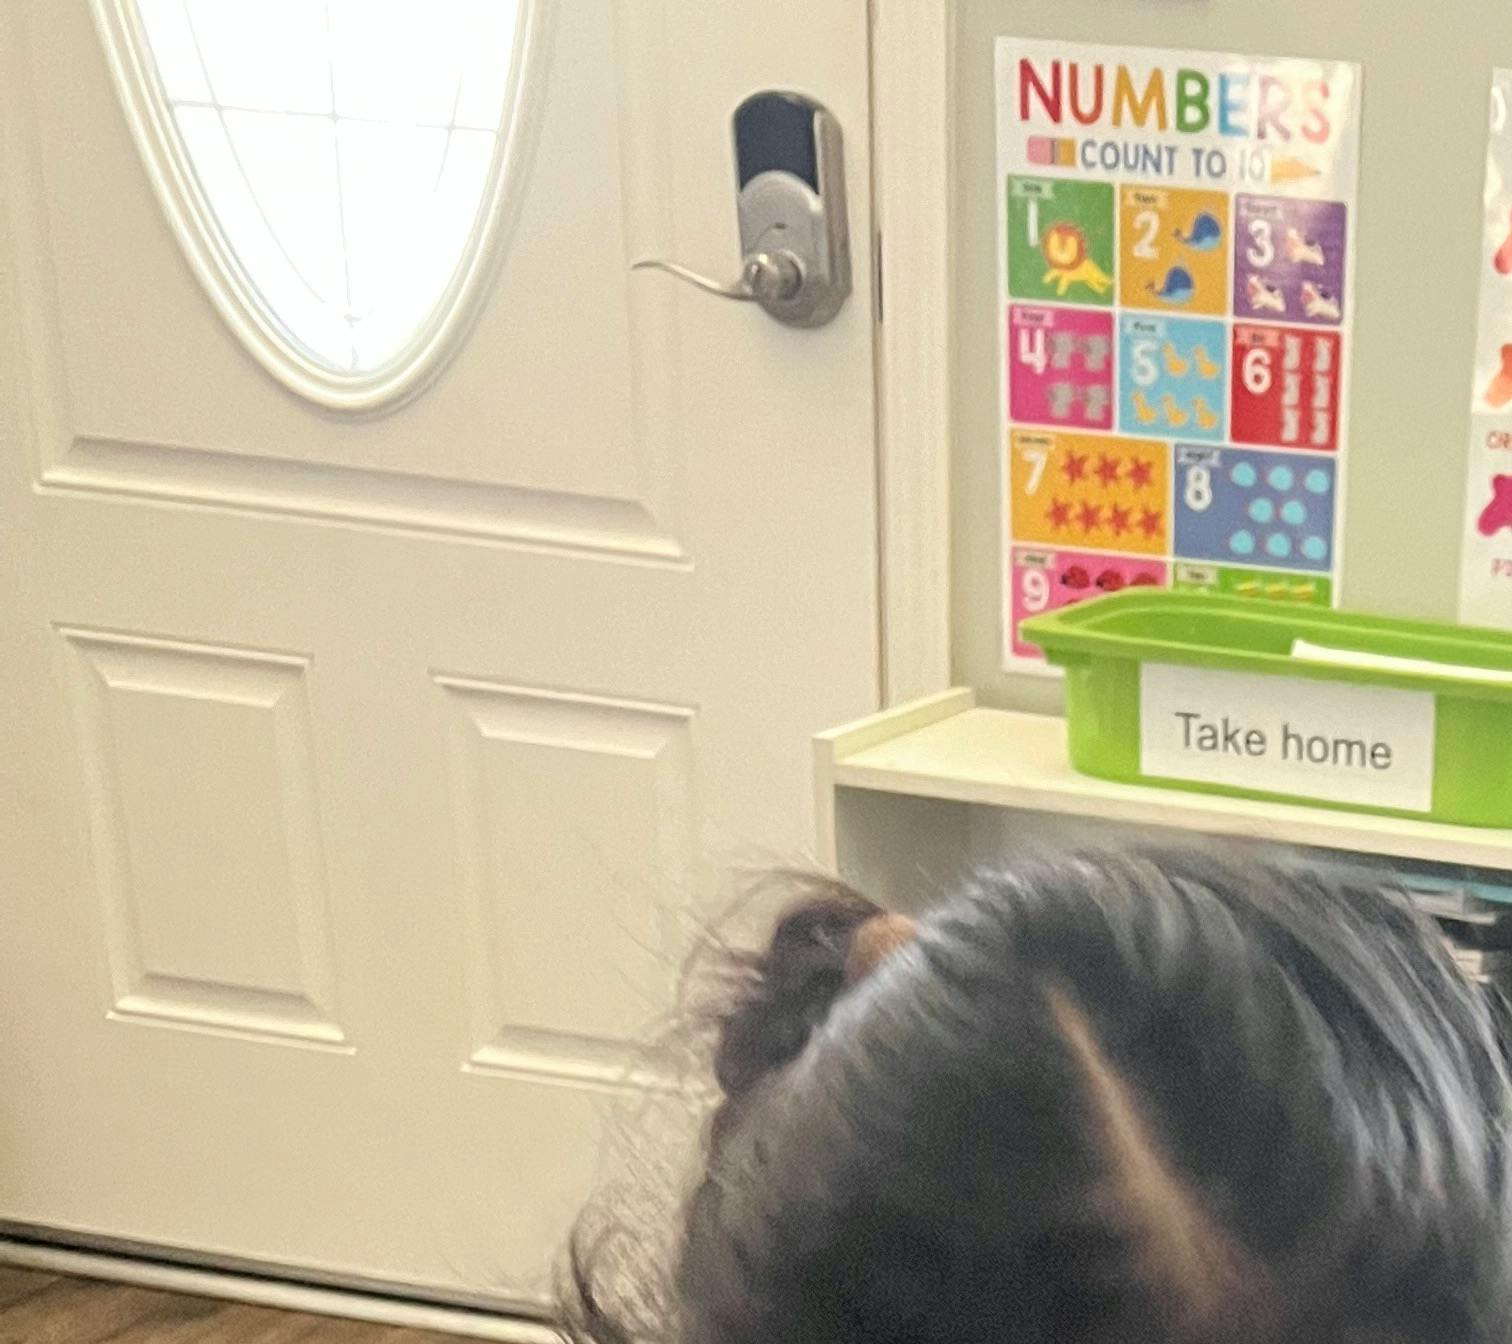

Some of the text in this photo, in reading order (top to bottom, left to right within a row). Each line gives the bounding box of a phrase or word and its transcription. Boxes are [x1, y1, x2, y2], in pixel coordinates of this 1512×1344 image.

[1018, 57, 1332, 144] NUMBERS
[1079, 139, 1267, 181] COUNT TO 10
[1026, 198, 1039, 248] 1
[1132, 211, 1160, 260] 2
[1246, 219, 1274, 268] 3
[1019, 327, 1047, 375] 4
[1132, 340, 1159, 386] 5
[1242, 348, 1272, 396] 6
[1021, 449, 1048, 496] 7
[1184, 465, 1213, 512] 8
[1021, 569, 1050, 613] 9
[1174, 711, 1393, 771] Take home
